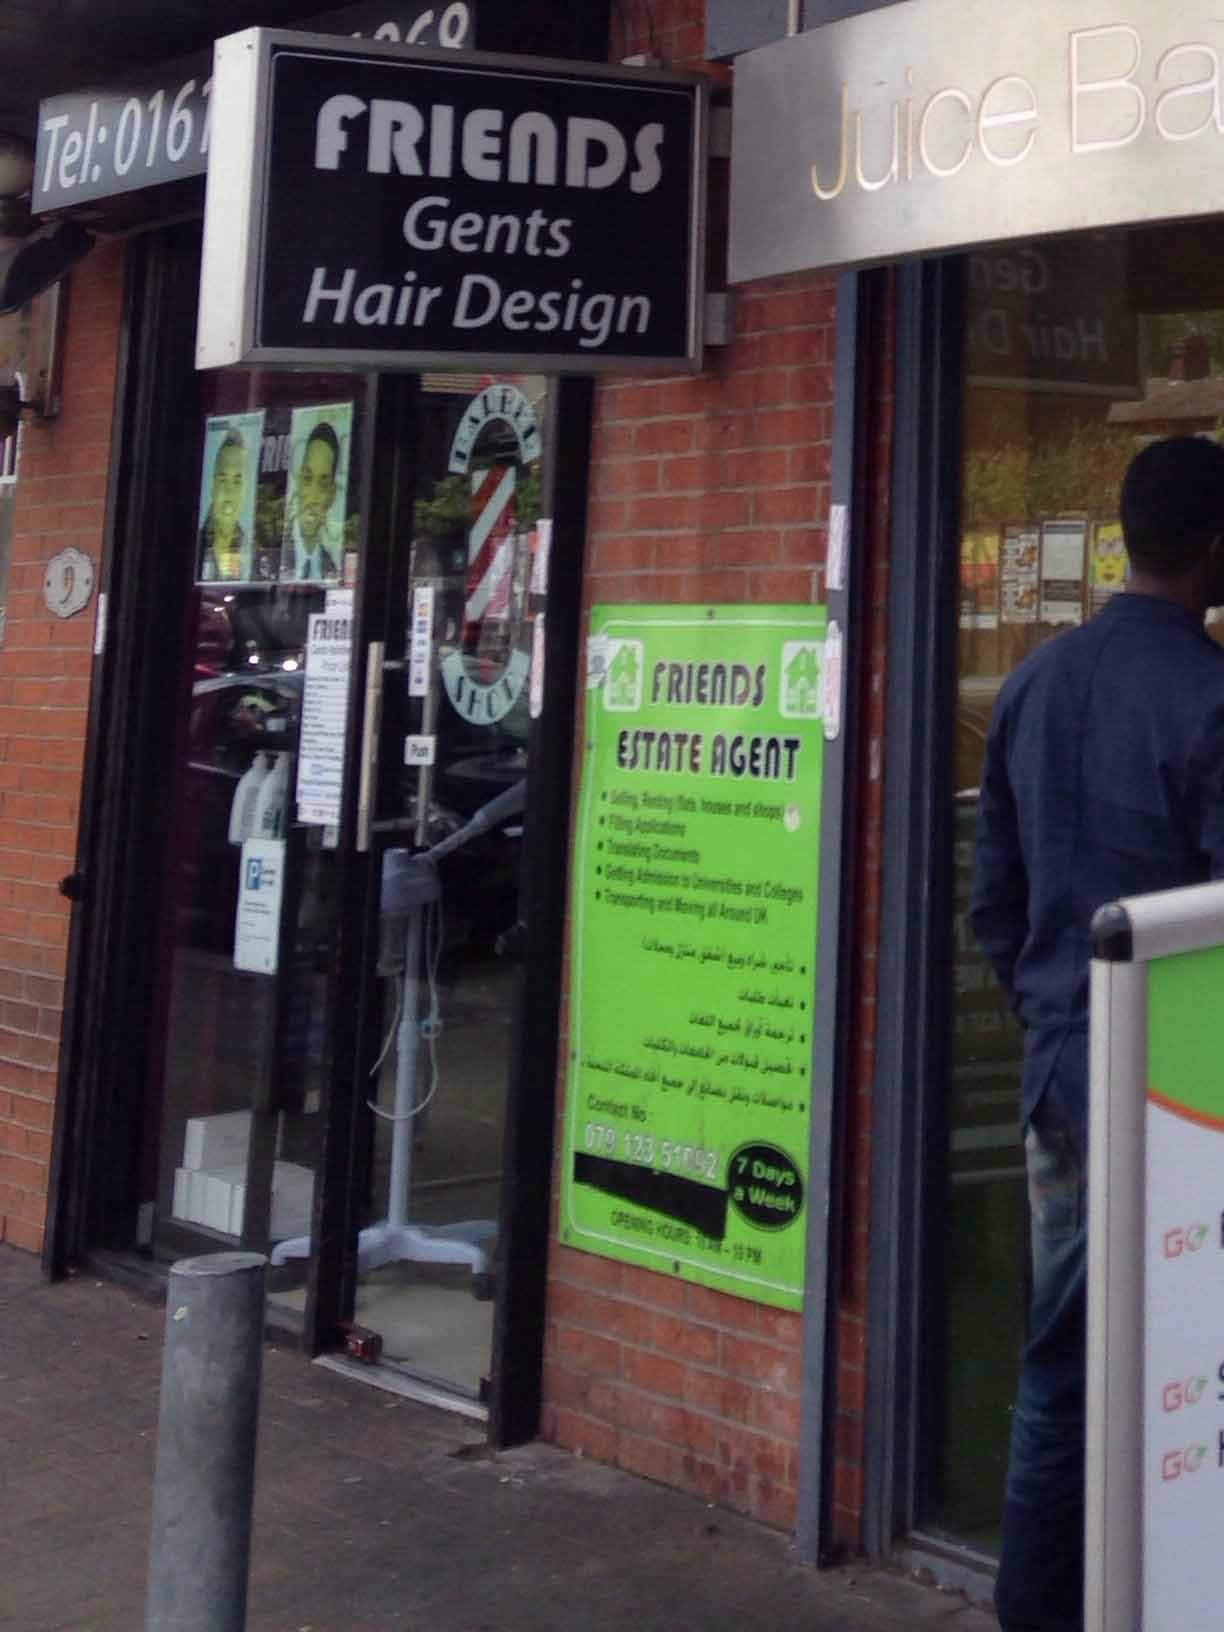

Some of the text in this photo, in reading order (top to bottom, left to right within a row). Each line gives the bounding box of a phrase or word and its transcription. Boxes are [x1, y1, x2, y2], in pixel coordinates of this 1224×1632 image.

[314, 95, 664, 193] FRIENDS
[811, 66, 1040, 200] Juice
[402, 196, 572, 257] Gents
[303, 268, 652, 347] Hair Design
[651, 662, 766, 707] FRIENDS
[616, 730, 800, 779] ESTATE AGENT
[748, 1185, 795, 1214] Week
[752, 1160, 796, 1186] Days
